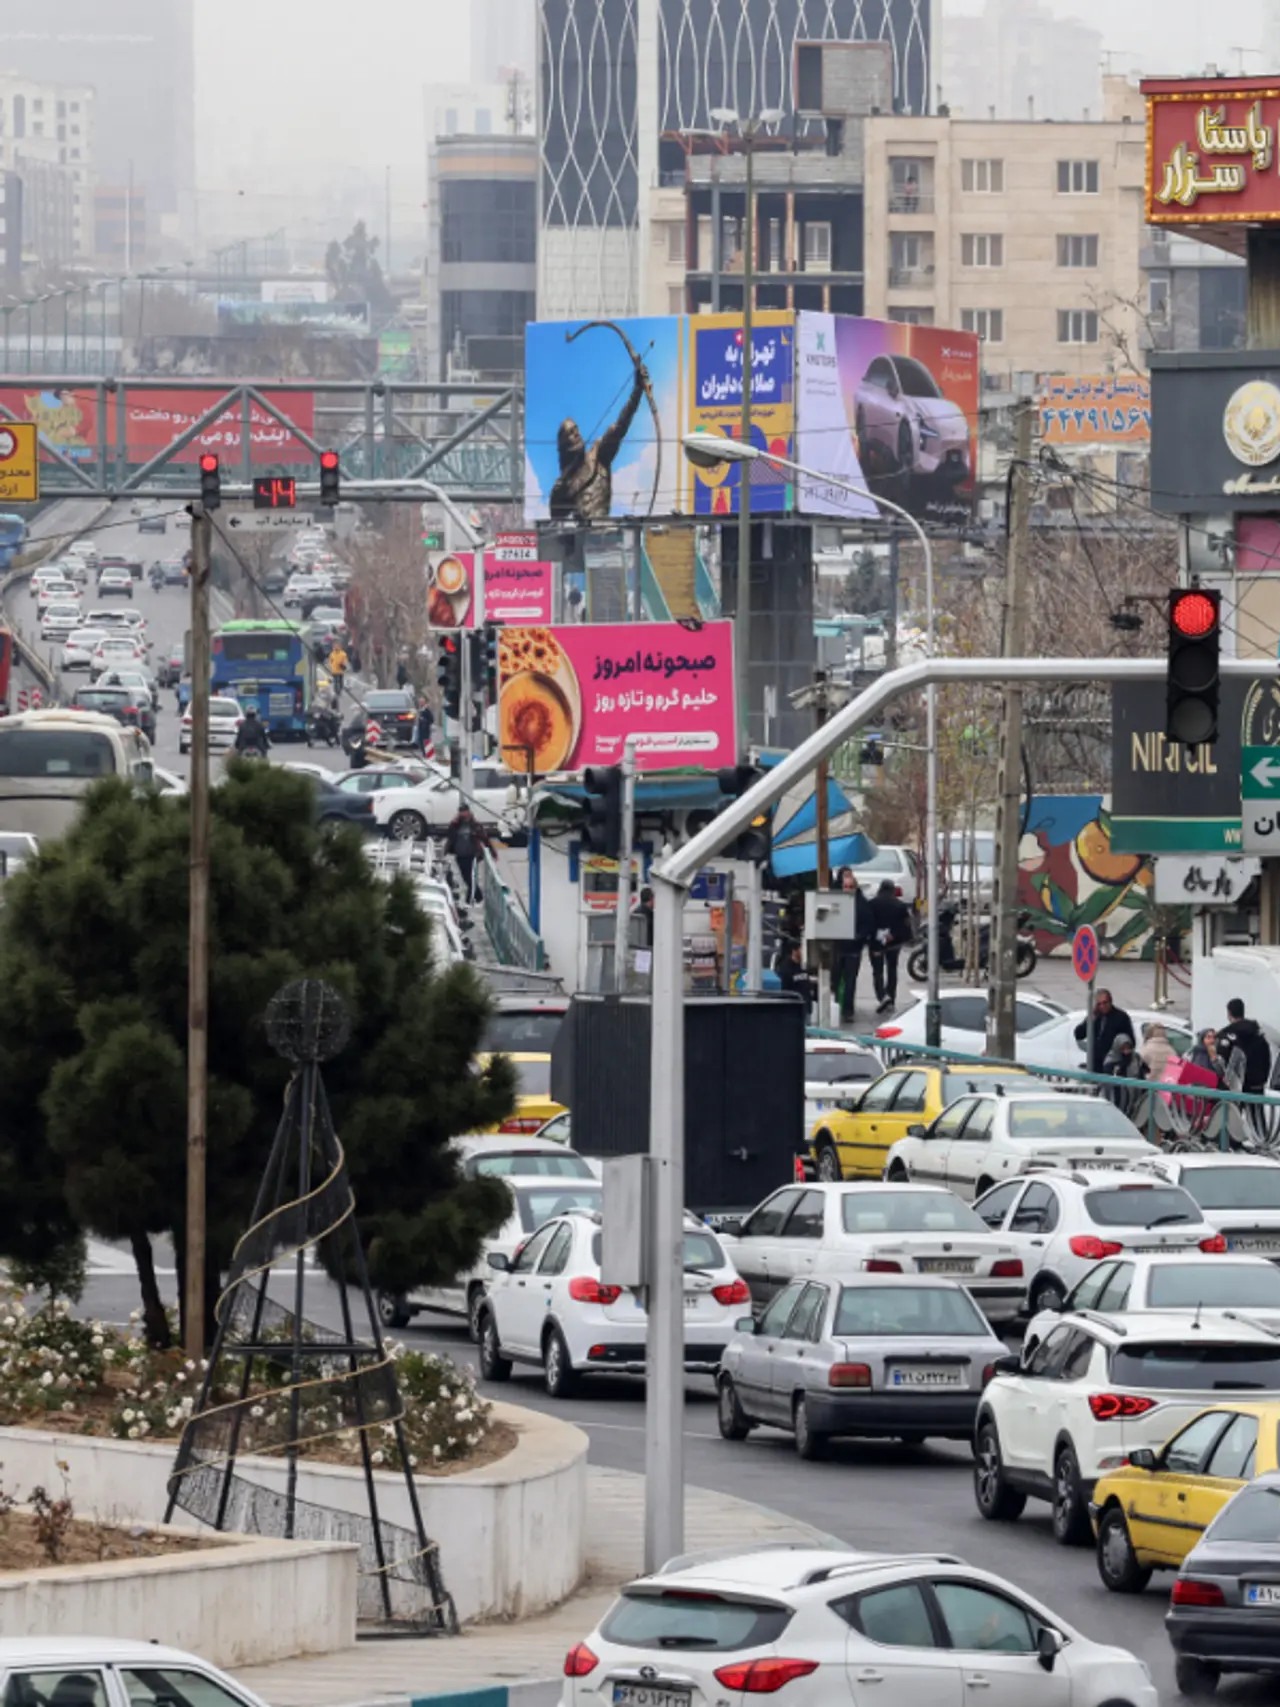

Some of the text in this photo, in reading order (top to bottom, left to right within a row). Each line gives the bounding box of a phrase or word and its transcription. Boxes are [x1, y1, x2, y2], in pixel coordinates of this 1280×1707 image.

[1196, 99, 1272, 171] پاستا
[1155, 141, 1246, 206] سزار
[740, 339, 776, 367] تهرا
[593, 650, 717, 680] صبحونه امروز
[594, 688, 718, 714] حلیم گرم و تازه روز
